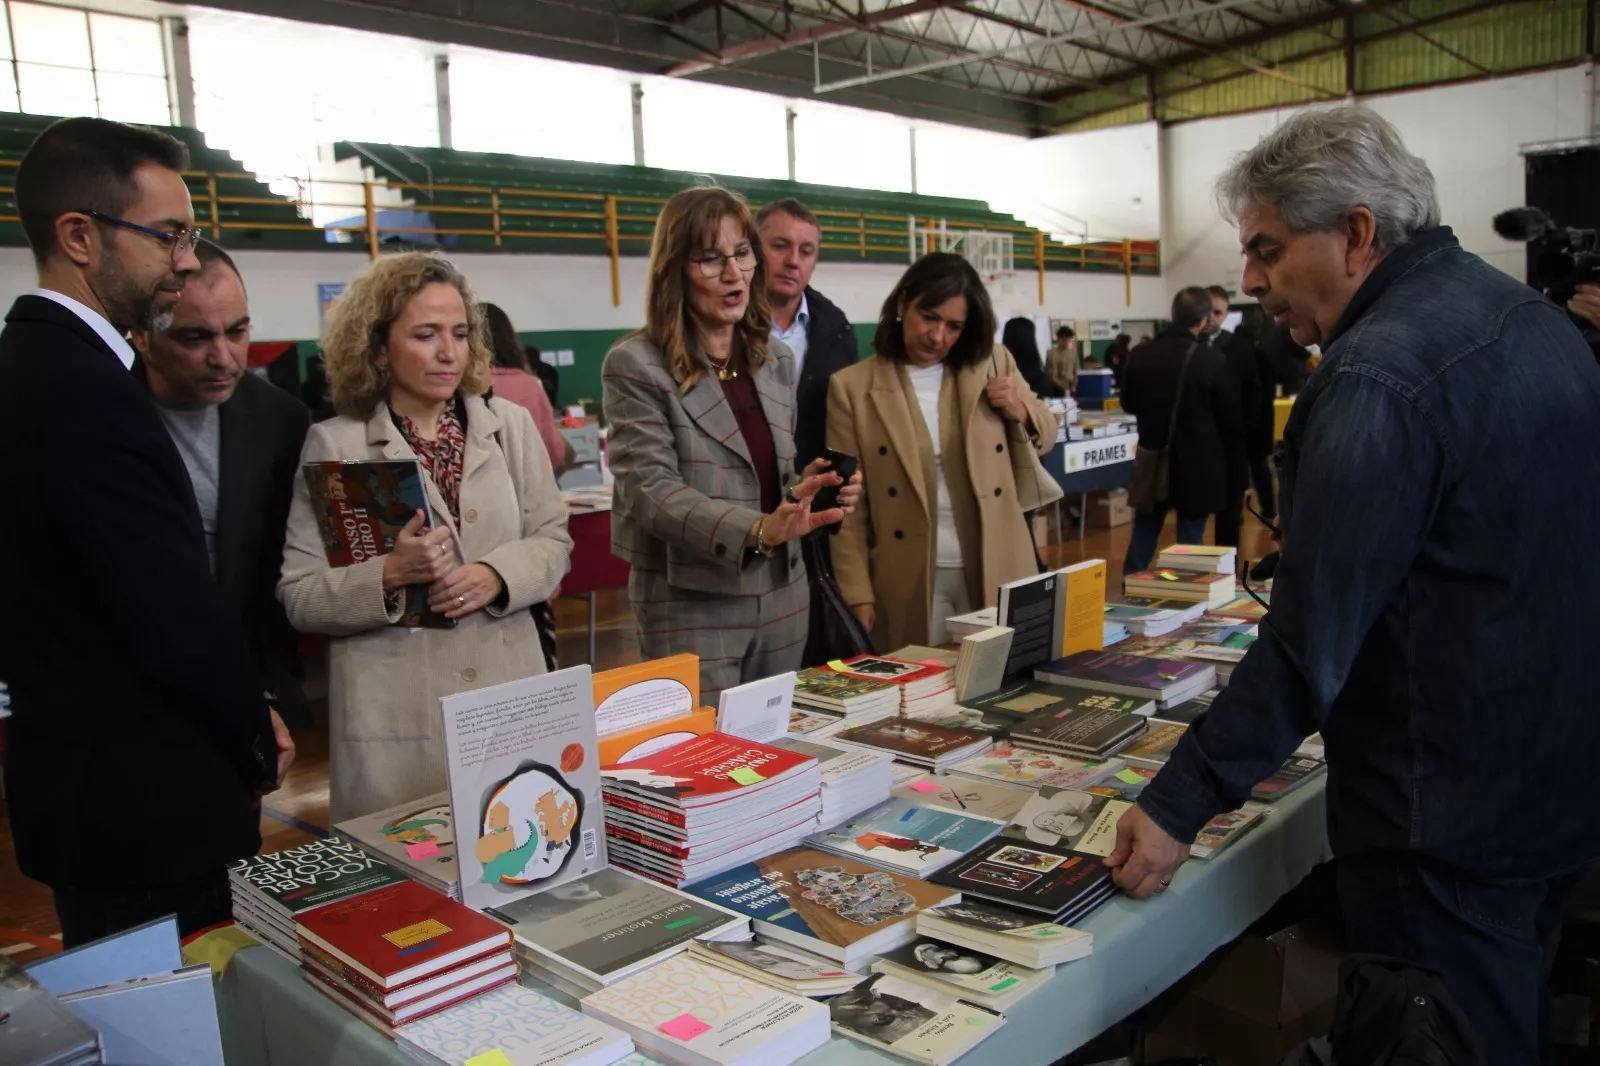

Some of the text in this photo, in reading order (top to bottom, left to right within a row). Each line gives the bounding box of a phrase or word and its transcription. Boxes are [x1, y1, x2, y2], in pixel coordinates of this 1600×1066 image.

[1084, 444, 1127, 467] PRAMES
[343, 518, 366, 564] ONSO
[245, 849, 370, 886] ALTOAR
[715, 870, 784, 899] del aragonés
[650, 902, 692, 921] María
[746, 892, 790, 911] Paisaje
[597, 918, 654, 942] Moliner
